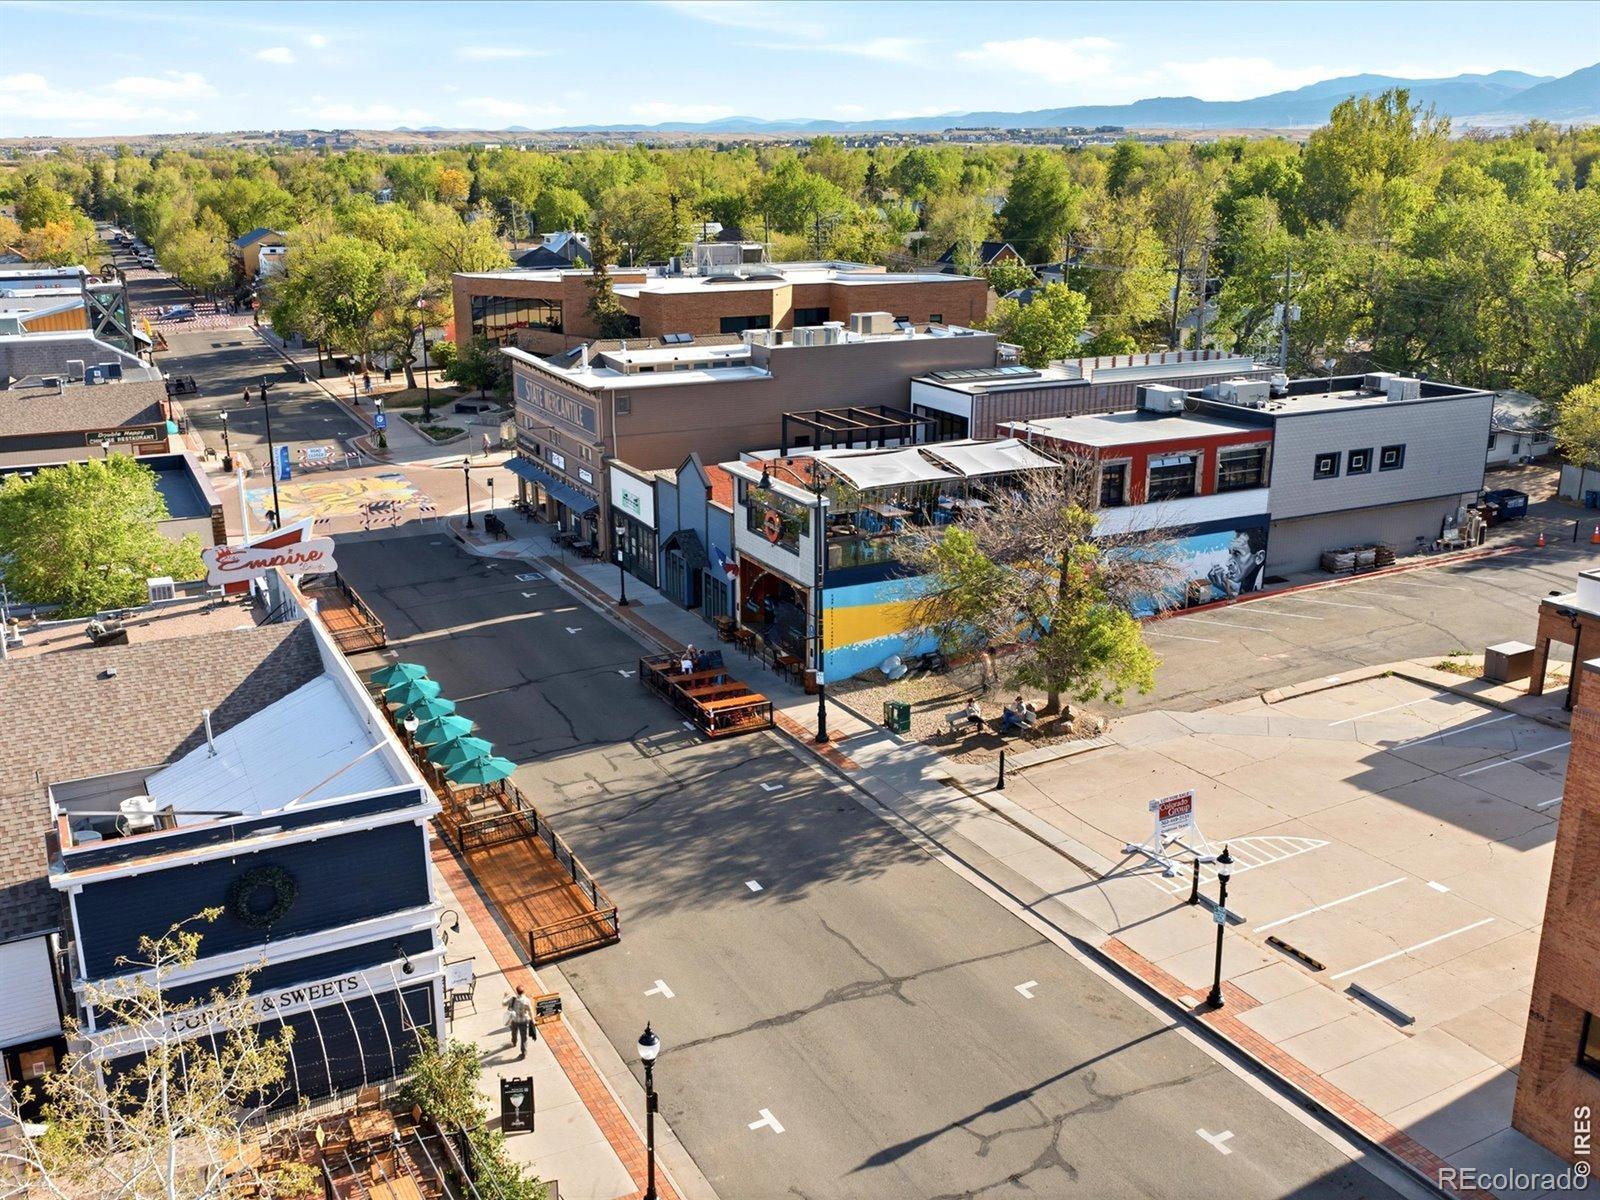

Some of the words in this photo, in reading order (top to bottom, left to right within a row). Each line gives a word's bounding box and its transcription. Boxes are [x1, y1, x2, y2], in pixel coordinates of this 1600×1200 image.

[525, 380, 543, 407] STATE
[544, 389, 584, 427] MERCANTILE
[215, 548, 323, 572] Empire
[1160, 799, 1189, 811] Colorado
[1167, 804, 1190, 816] Group
[261, 993, 275, 1012] &
[280, 976, 359, 1008] SWEETS
